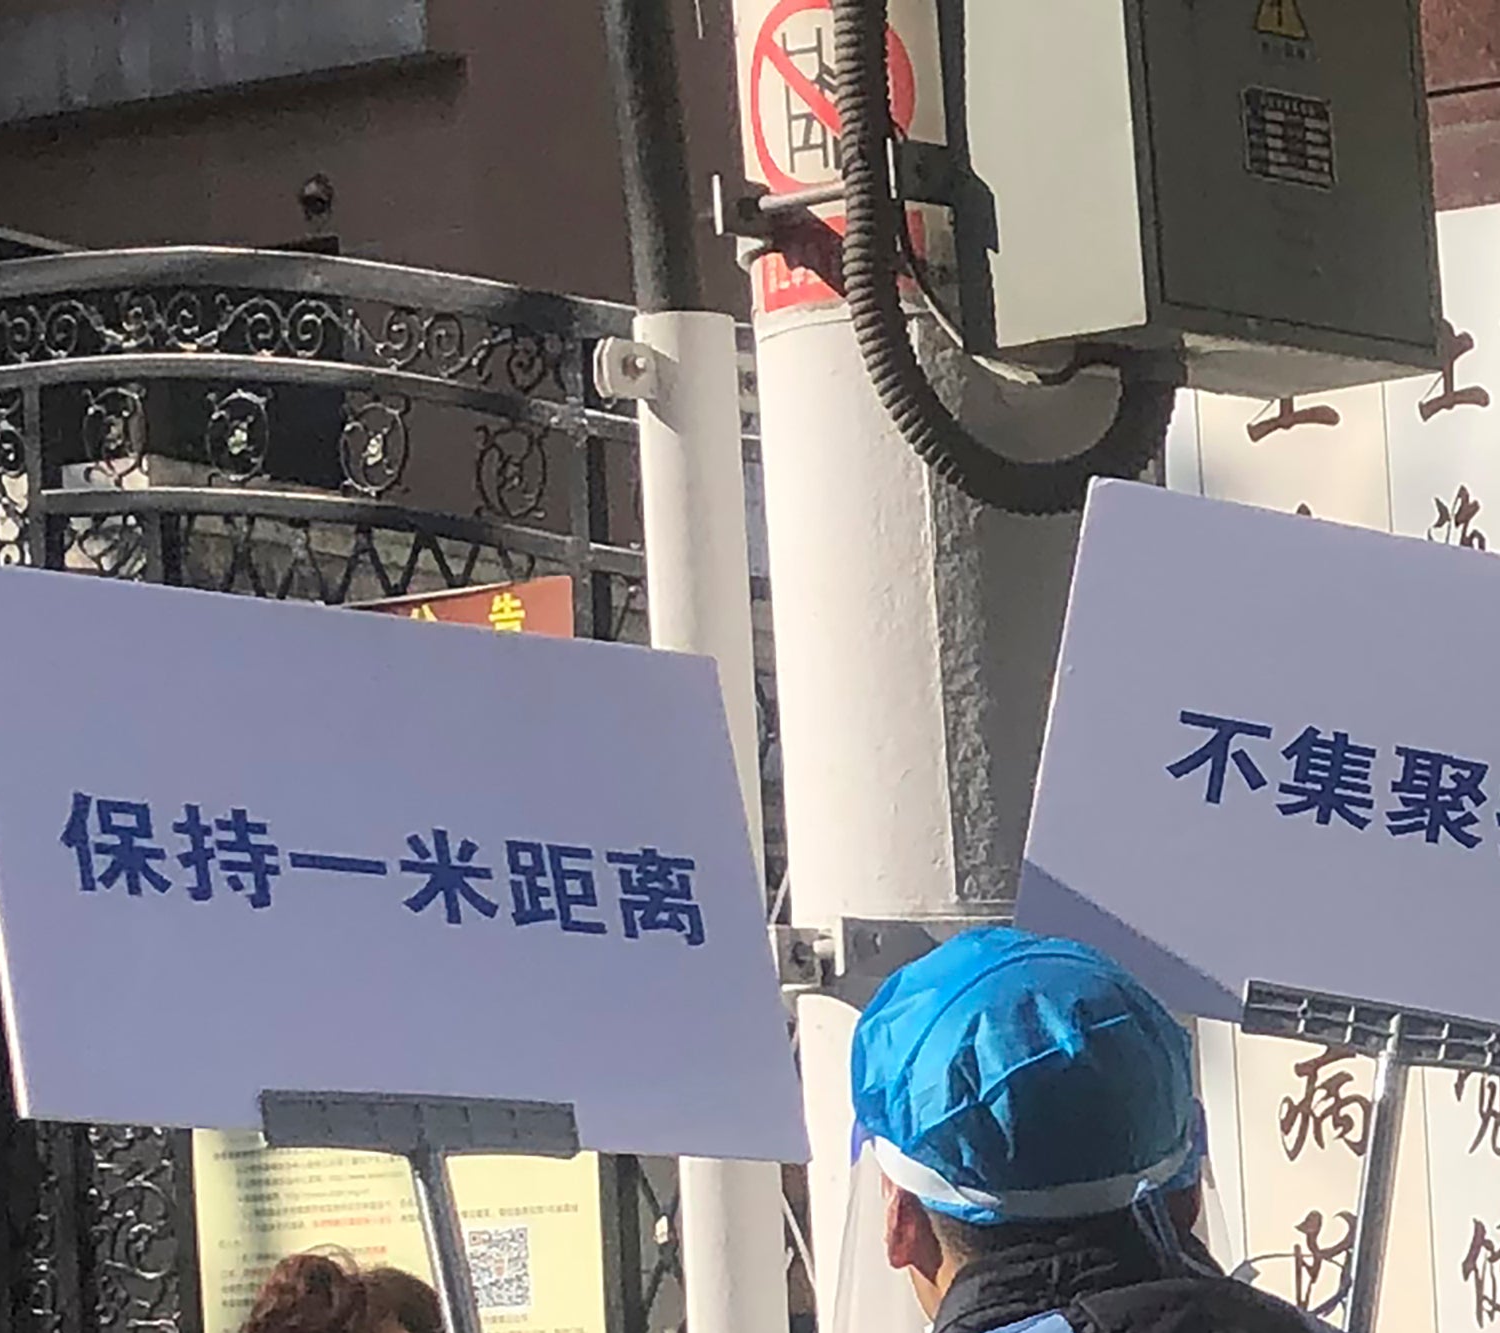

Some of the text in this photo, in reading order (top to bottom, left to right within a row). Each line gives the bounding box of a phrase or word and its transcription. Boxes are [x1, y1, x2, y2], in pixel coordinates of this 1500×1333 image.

[60, 791, 706, 947] 保持一米距离
